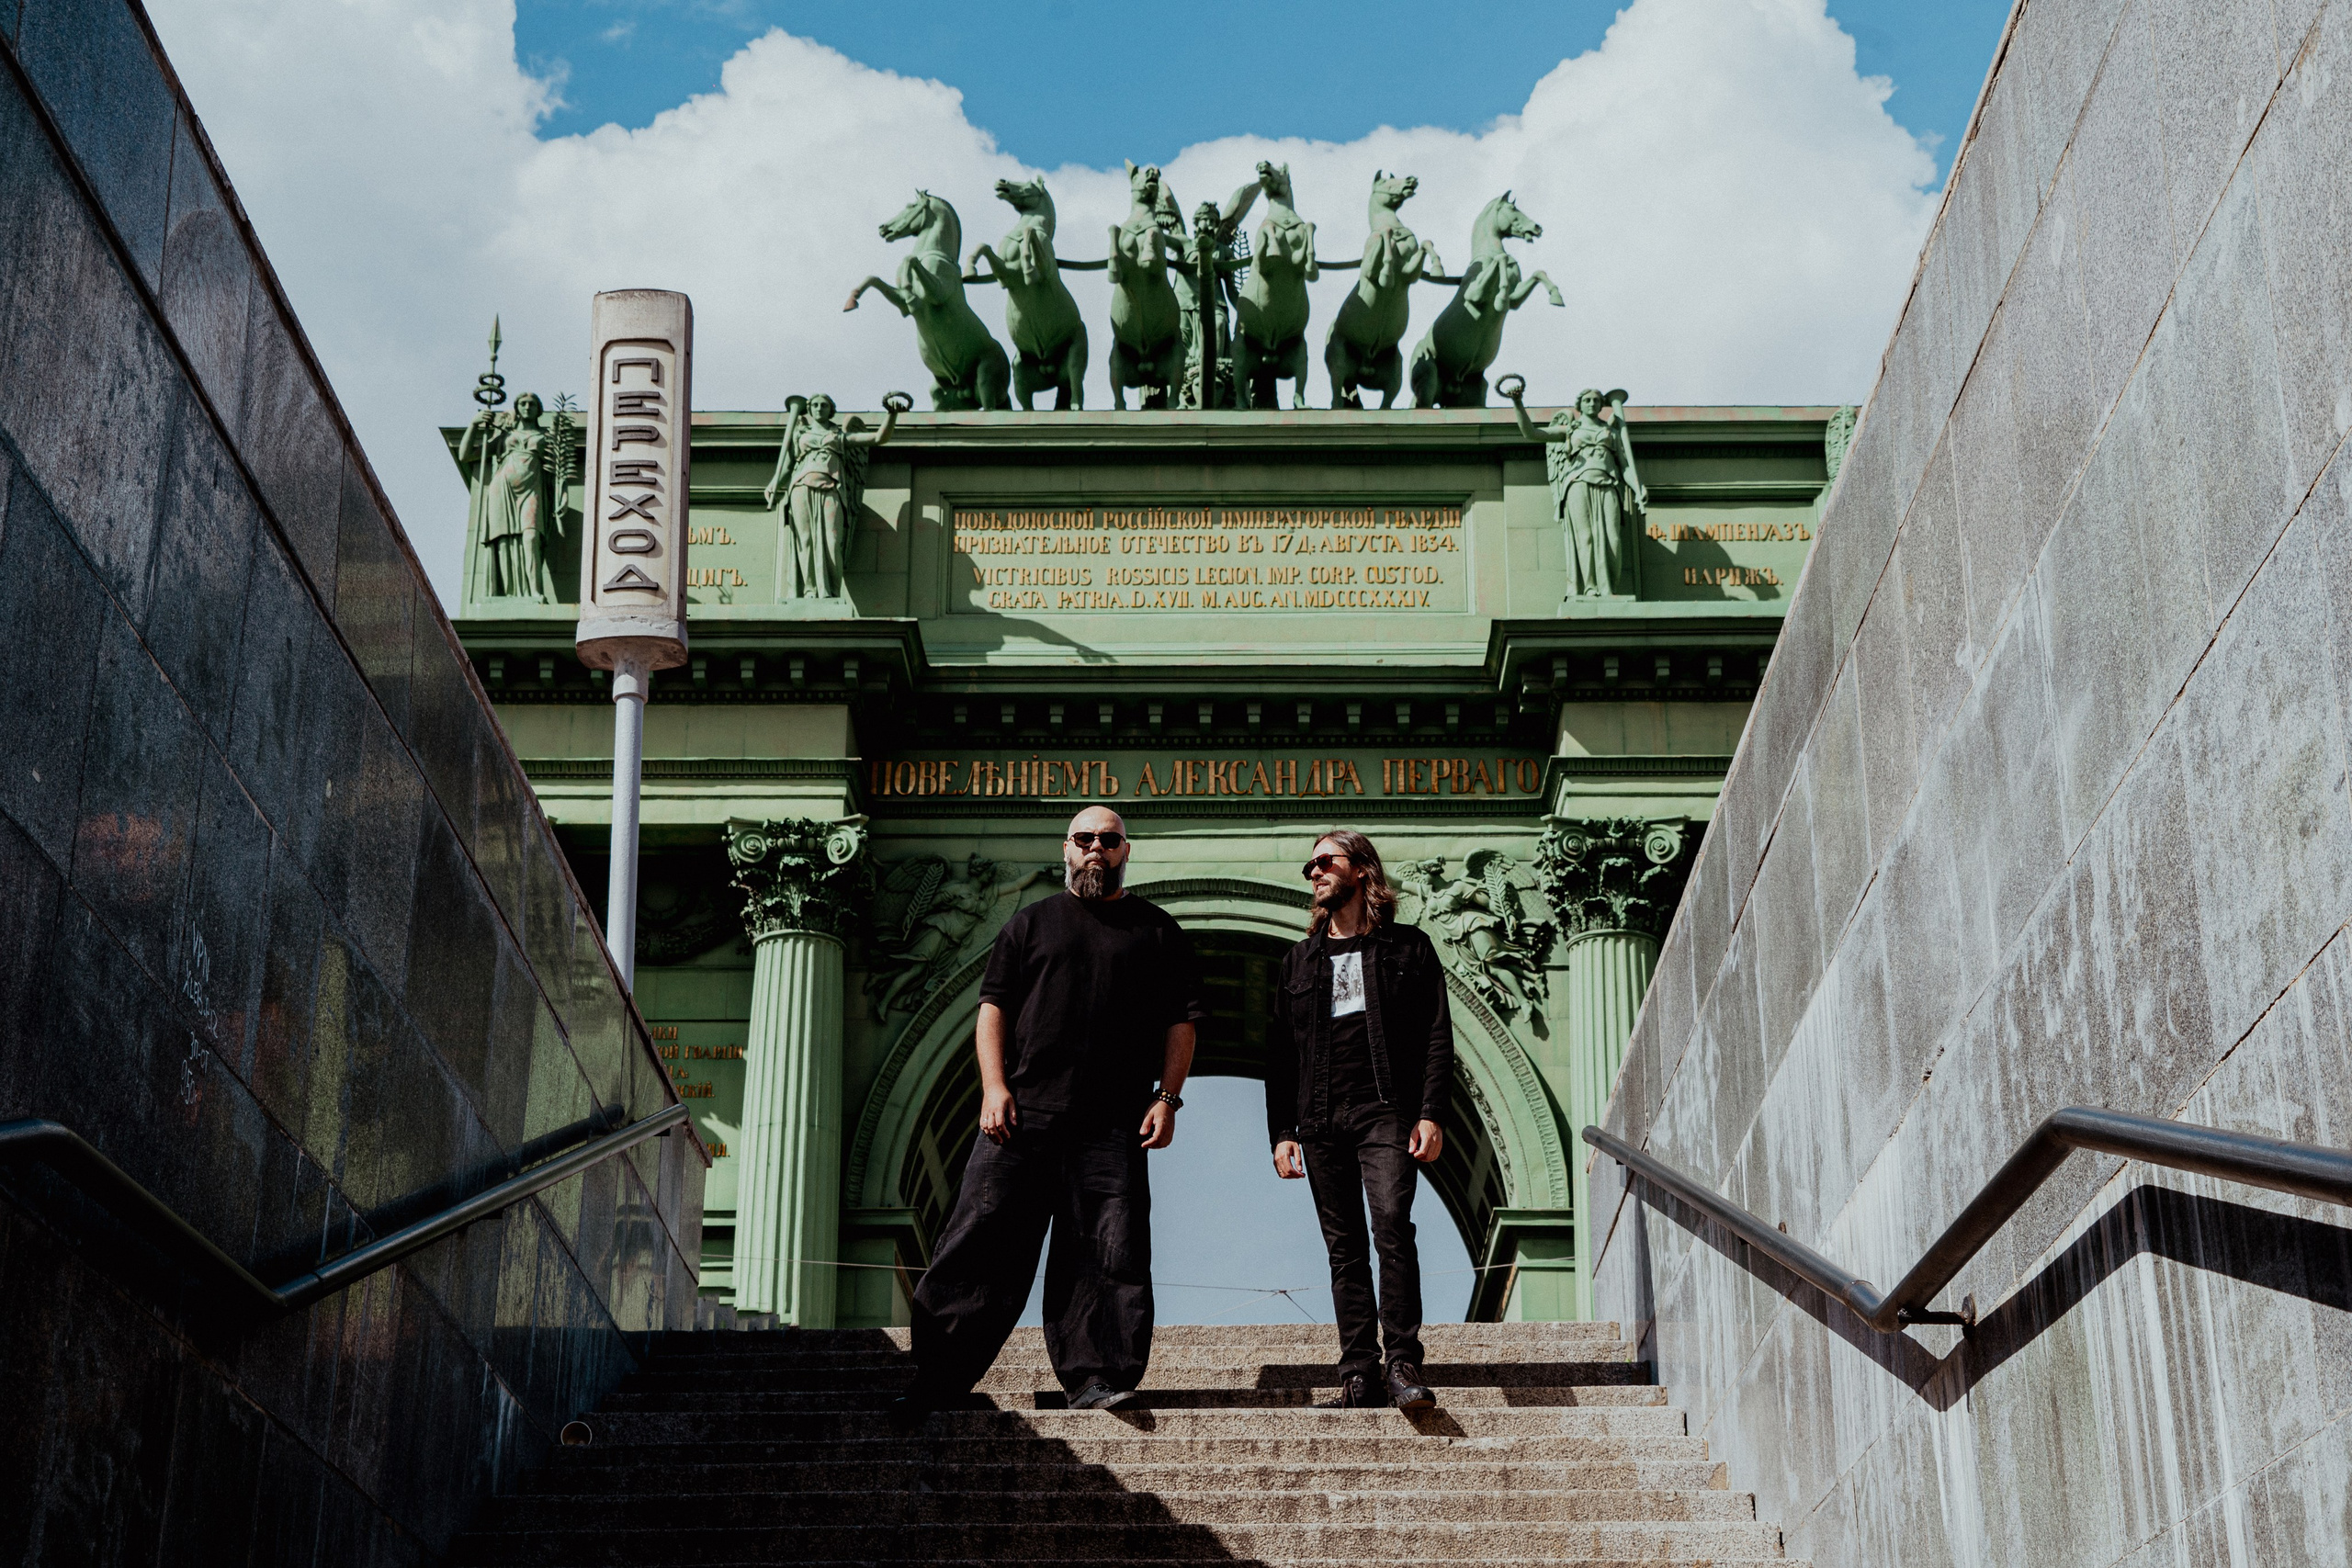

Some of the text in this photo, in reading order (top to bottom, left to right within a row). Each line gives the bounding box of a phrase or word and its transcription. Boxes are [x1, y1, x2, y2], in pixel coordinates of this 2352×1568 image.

[603, 357, 660, 592] ПЕРЕХОД
[1220, 507, 1376, 530] ИМПЕРАТОРСКОЙ
[954, 535, 1111, 555] ПРИЗНАТЕЛЬНОЕ
[1118, 535, 1230, 554] ОТЕЧЕСТВО
[1237, 535, 1264, 553] ВЪ
[1318, 535, 1404, 554] АВГУСТА
[1409, 534, 1459, 553] 1834.
[972, 565, 1444, 586] VICTRICIBUS ROSSICIS LEGION. IMP. CORP. CUSTOD.
[1683, 567, 1784, 586] ПАРИЖЪ.
[989, 591, 1048, 608] GRATA
[1134, 760, 1365, 797] АЛЕКСАНДРА
